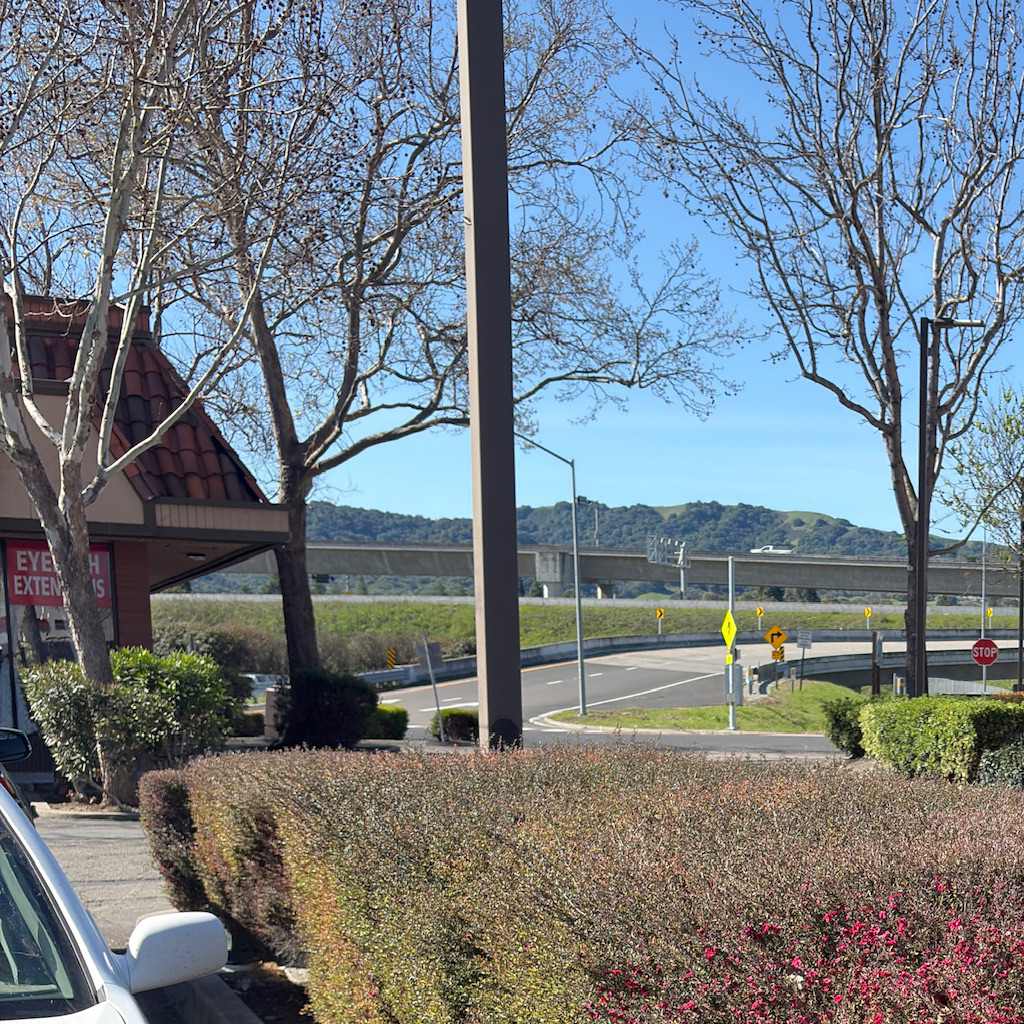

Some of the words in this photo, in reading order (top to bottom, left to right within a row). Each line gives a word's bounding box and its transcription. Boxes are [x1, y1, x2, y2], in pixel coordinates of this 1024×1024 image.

[16, 550, 99, 575] EYEH
[14, 575, 105, 599] EXTENS
[973, 647, 997, 658] STOP
